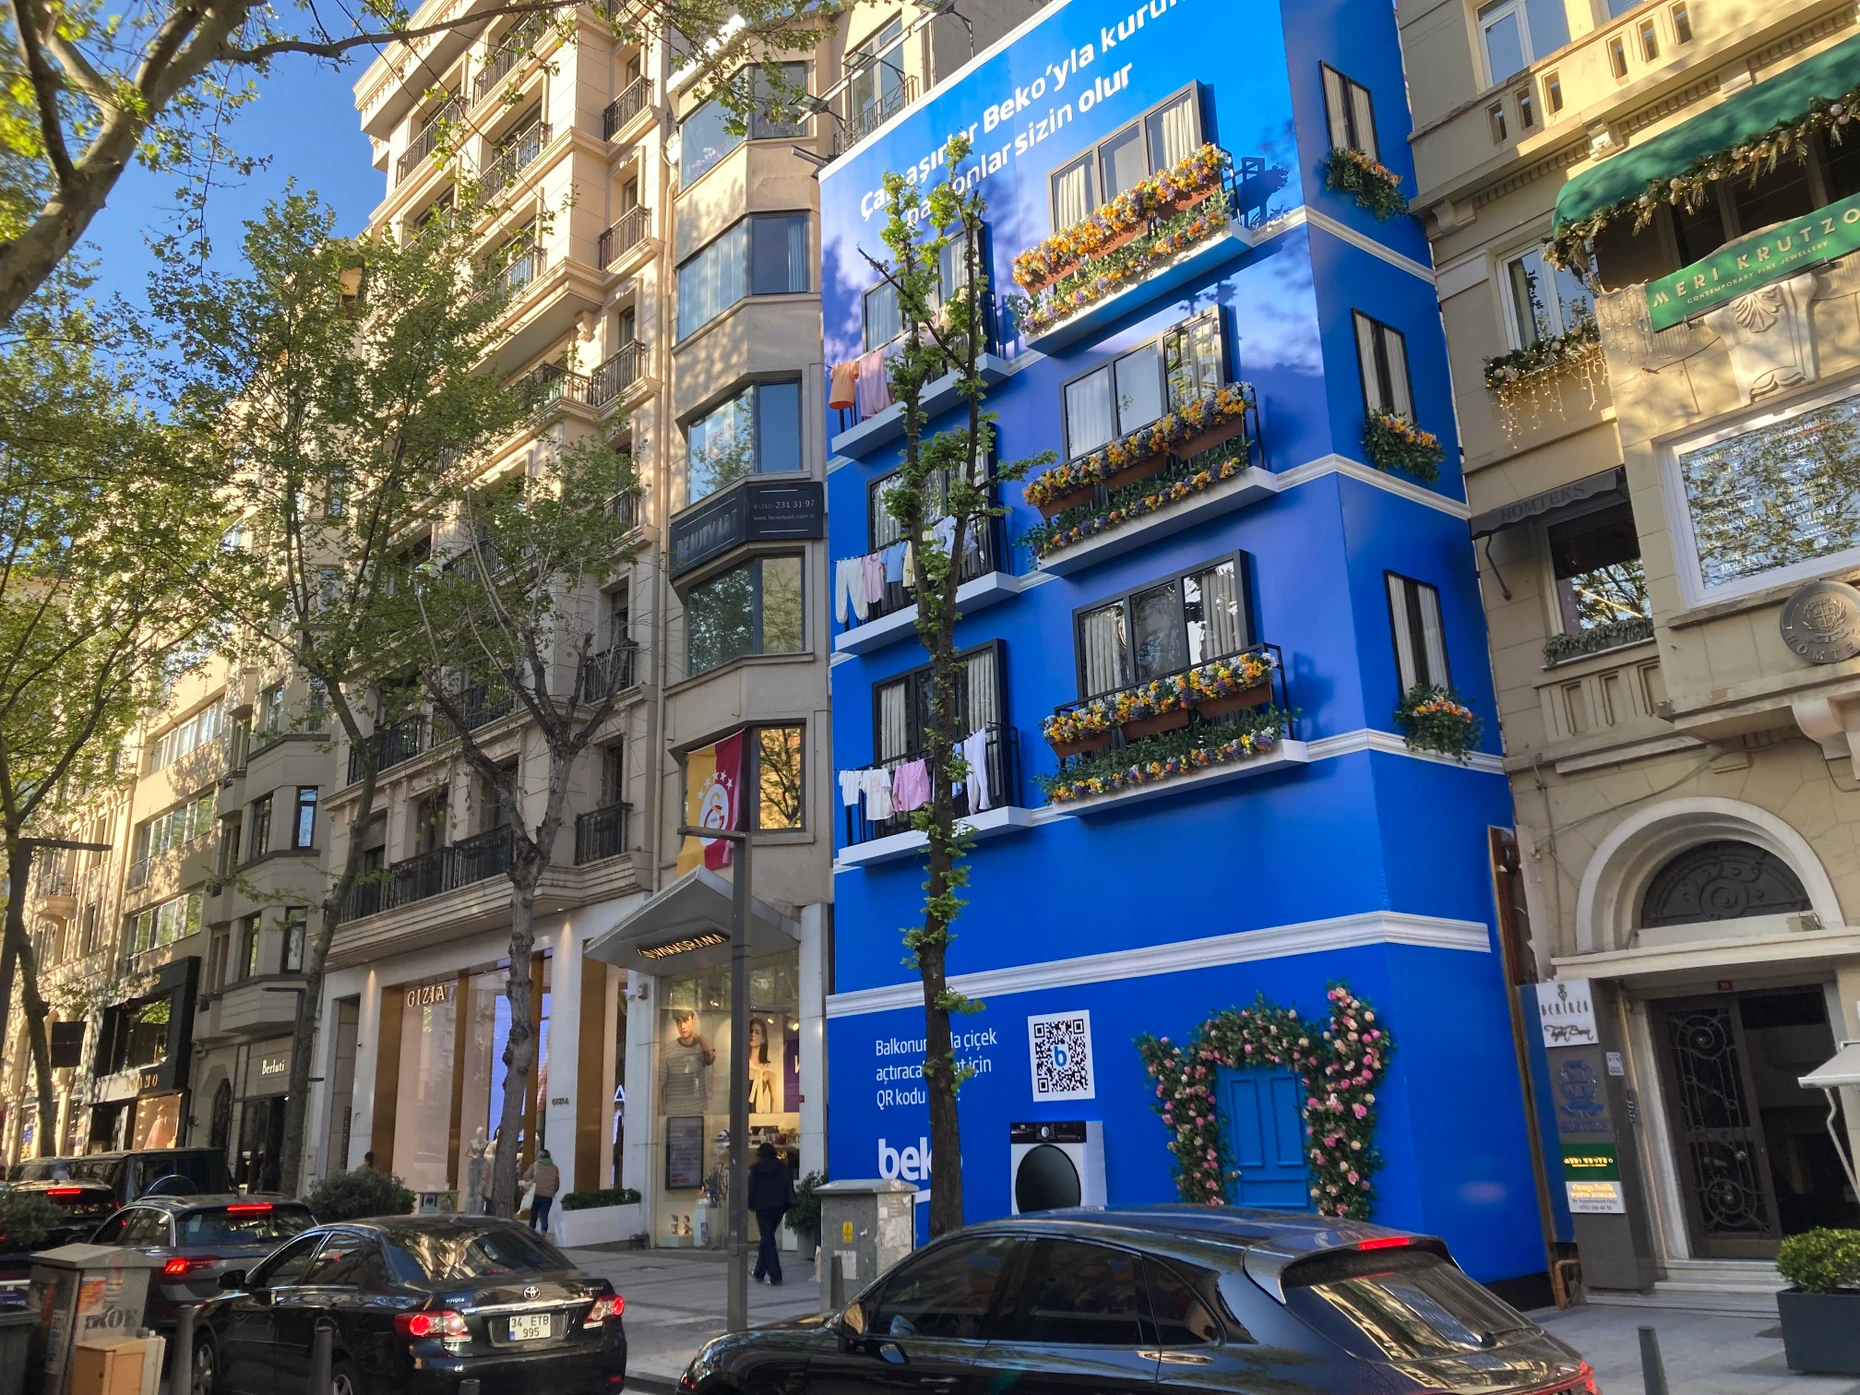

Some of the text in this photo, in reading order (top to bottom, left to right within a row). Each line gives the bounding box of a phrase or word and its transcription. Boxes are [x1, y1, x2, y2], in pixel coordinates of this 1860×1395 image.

[1014, 103, 1073, 156] sizin
[1078, 62, 1133, 114] olur
[1687, 240, 1828, 304] CONTEMPORARY FINE JEWELLERY
[1653, 267, 1719, 308] MERI
[775, 501, 791, 509] 231
[792, 500, 802, 508] 31
[804, 499, 815, 508] 97
[1500, 484, 1585, 521] HOMTEKS
[676, 520, 715, 562] BEAUTY
[407, 985, 446, 1007] GIZIA
[963, 1027, 998, 1051] çiçek
[262, 1059, 285, 1075] Berluti
[876, 1087, 926, 1111] QR kodu
[878, 1136, 963, 1181] bek
[511, 1315, 550, 1328] 34 ETB
[522, 1327, 540, 1338] 995
